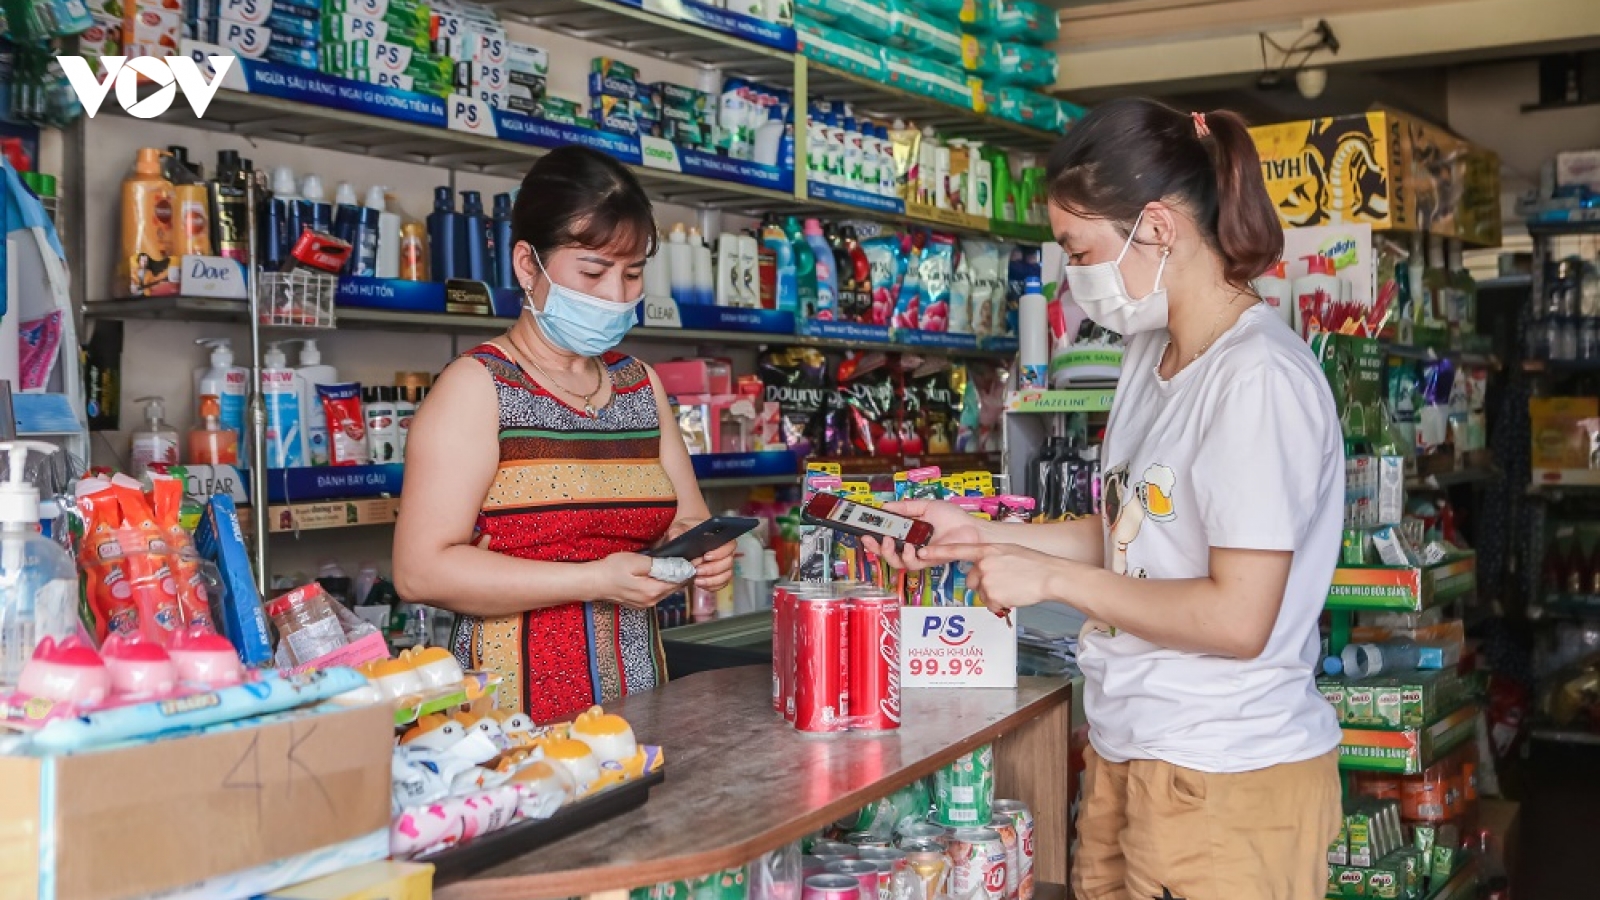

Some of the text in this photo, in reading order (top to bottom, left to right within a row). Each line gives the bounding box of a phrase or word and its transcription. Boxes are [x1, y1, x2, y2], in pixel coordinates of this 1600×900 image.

[191, 259, 230, 281] Dove
[346, 472, 364, 486] BAY
[1352, 585, 1370, 597] MILO
[909, 645, 983, 658] KHÁNG KHUẨN
